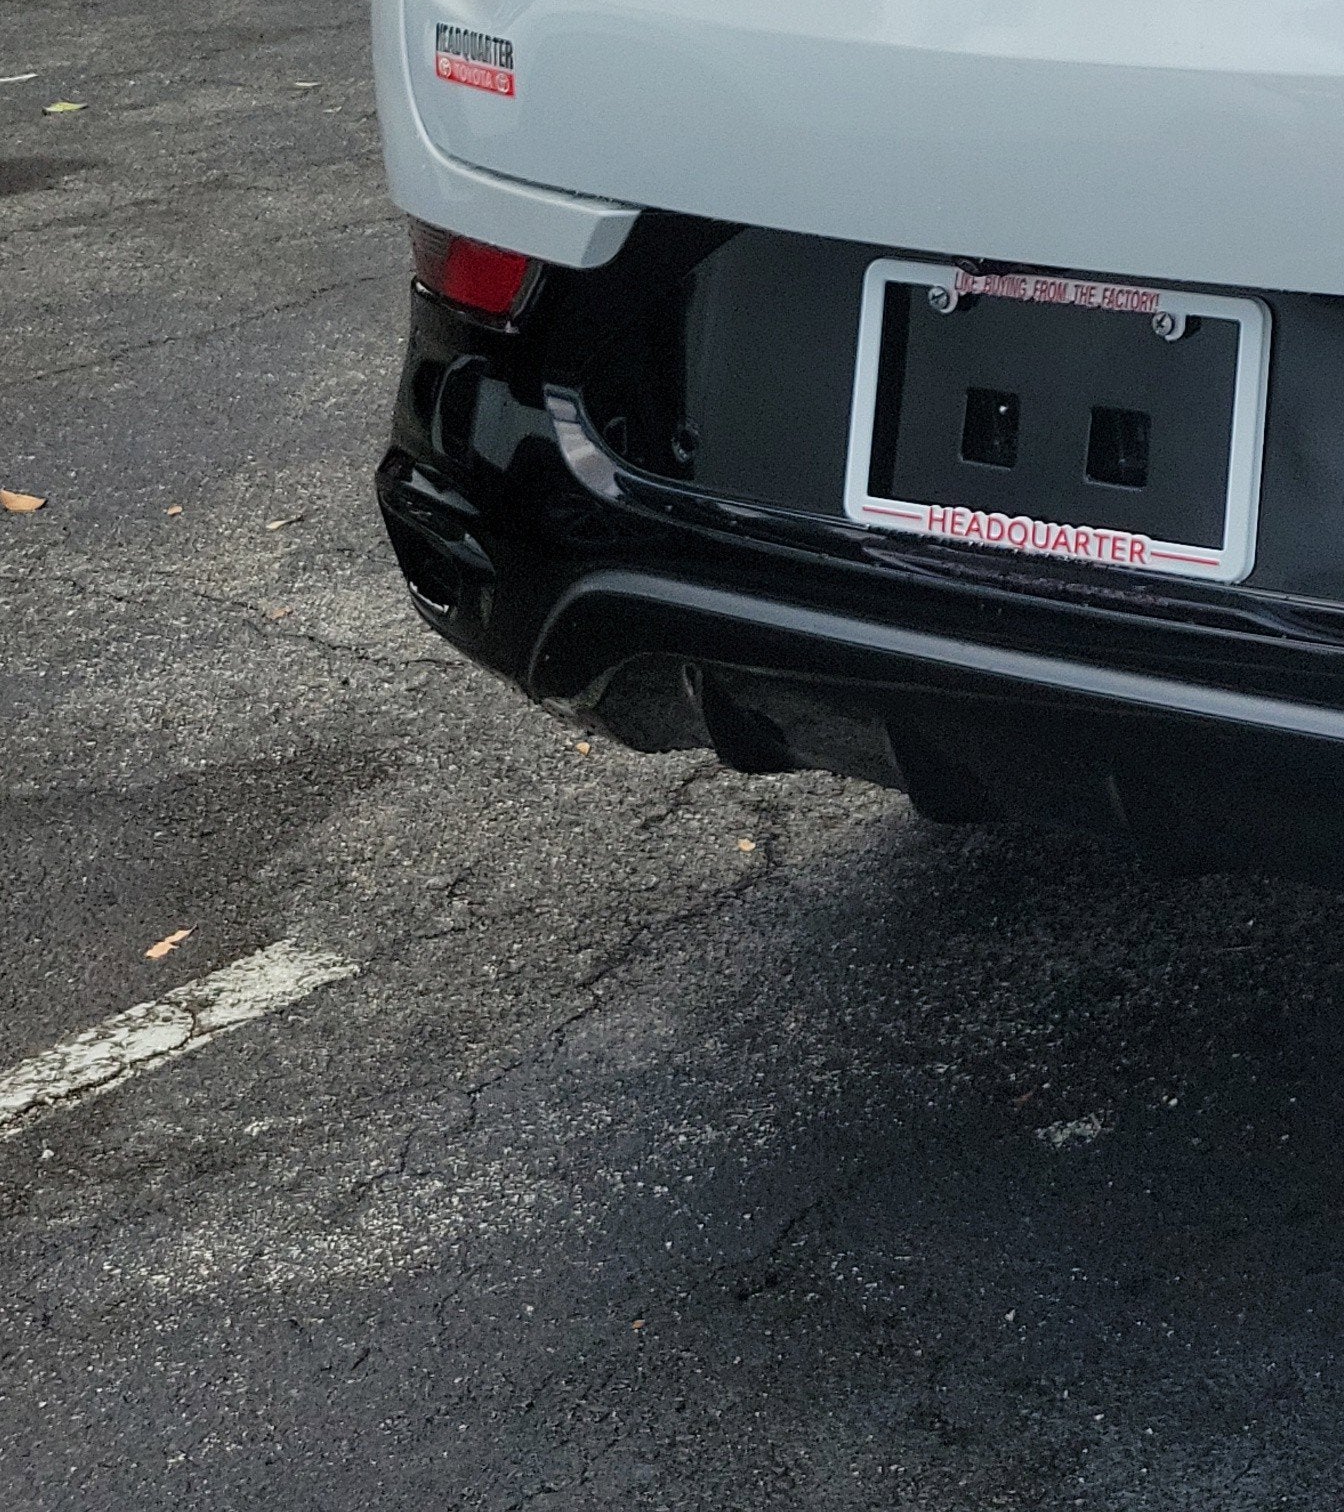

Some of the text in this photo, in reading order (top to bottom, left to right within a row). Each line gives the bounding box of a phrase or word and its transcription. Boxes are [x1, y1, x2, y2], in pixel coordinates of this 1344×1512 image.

[436, 23, 513, 70] HEADQUARTER
[955, 272, 1160, 313] LIKE BUYING FROM THE FACTORY!
[928, 505, 1147, 565] HEADQUARTER
